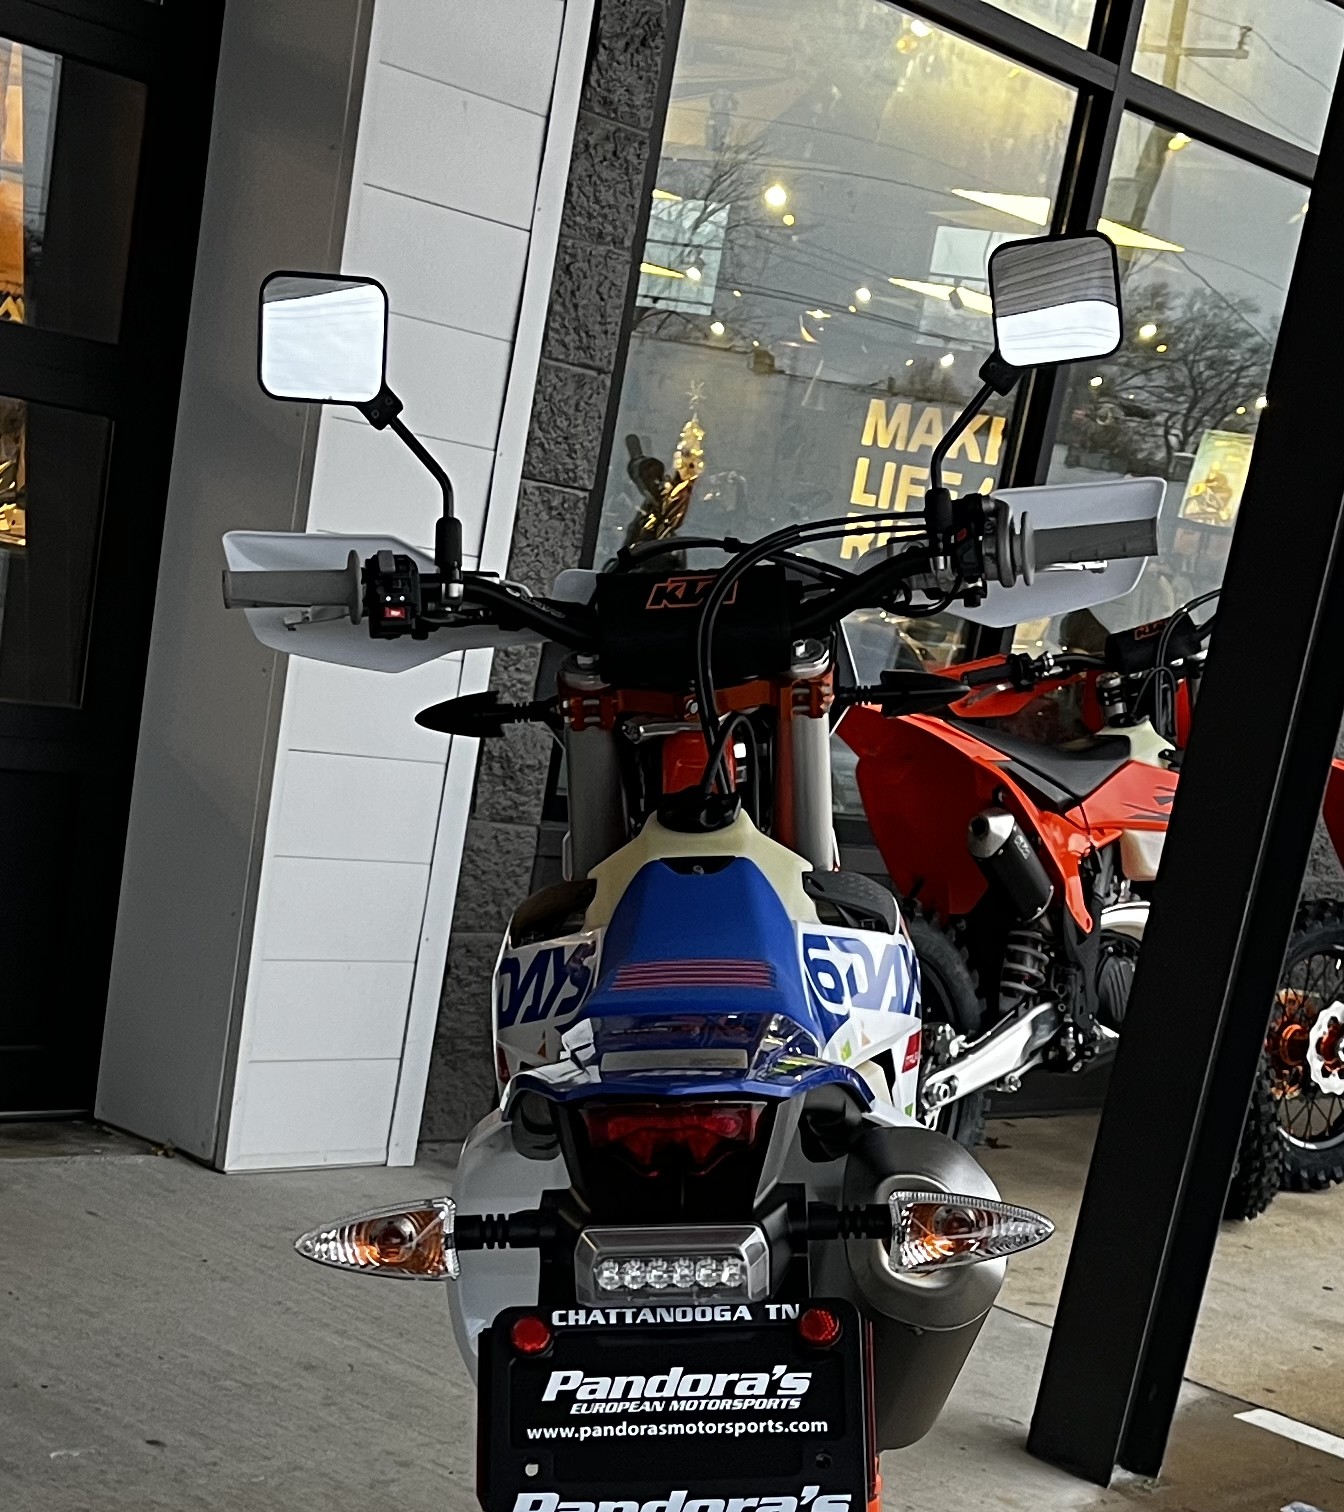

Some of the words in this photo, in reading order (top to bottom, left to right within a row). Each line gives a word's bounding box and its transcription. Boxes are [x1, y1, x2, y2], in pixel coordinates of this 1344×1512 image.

[551, 1305, 753, 1326] CHATTANOOGA
[764, 1303, 800, 1320] TN
[541, 1365, 812, 1402] Pandora's
[569, 1400, 666, 1415] EUROPEAN
[668, 1398, 802, 1412] MOTORSPORTS
[526, 1419, 828, 1442] www.pandorasmotorsports.com
